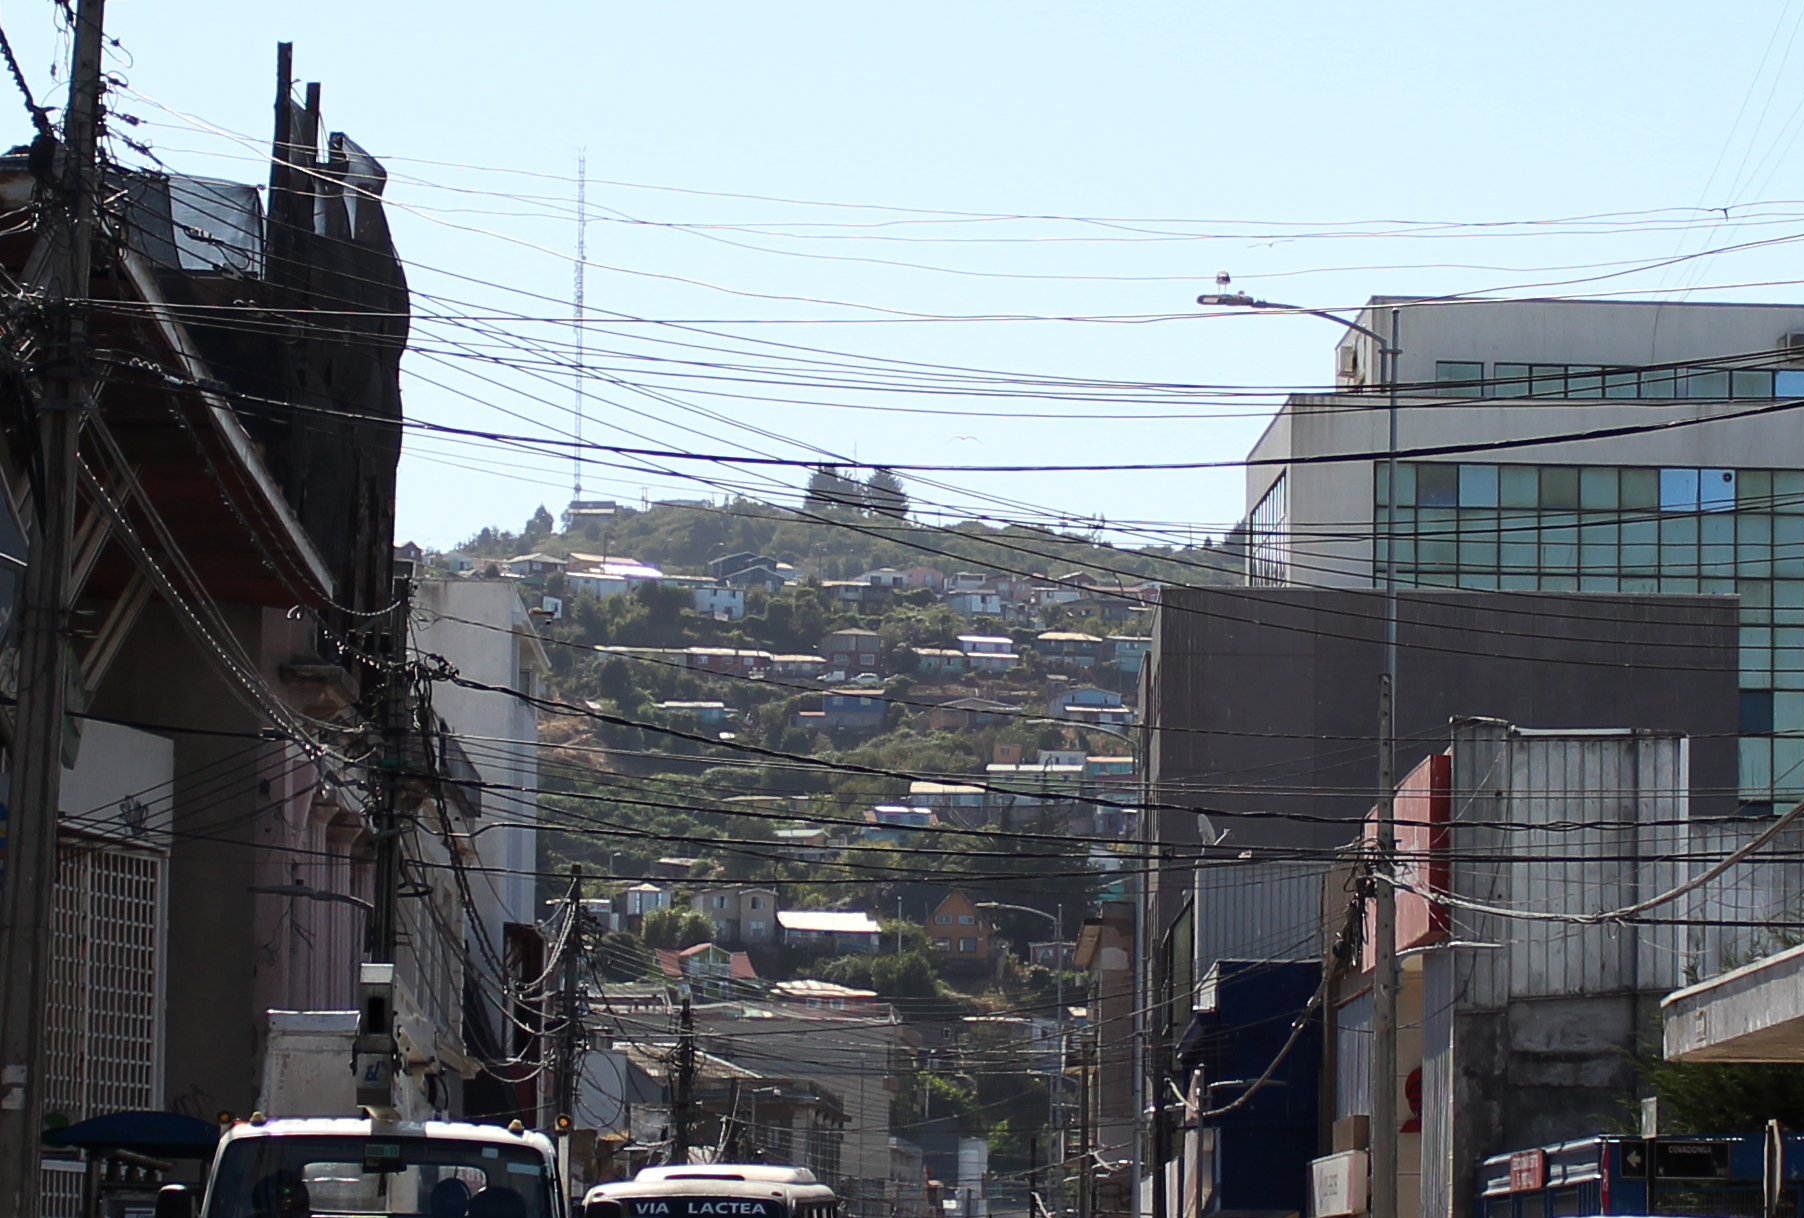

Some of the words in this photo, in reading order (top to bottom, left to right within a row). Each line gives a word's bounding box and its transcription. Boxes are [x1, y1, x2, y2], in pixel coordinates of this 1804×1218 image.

[1668, 1145, 1713, 1155] COVADONGA
[637, 1202, 670, 1215] VIA
[687, 1202, 767, 1215] LACTEA
